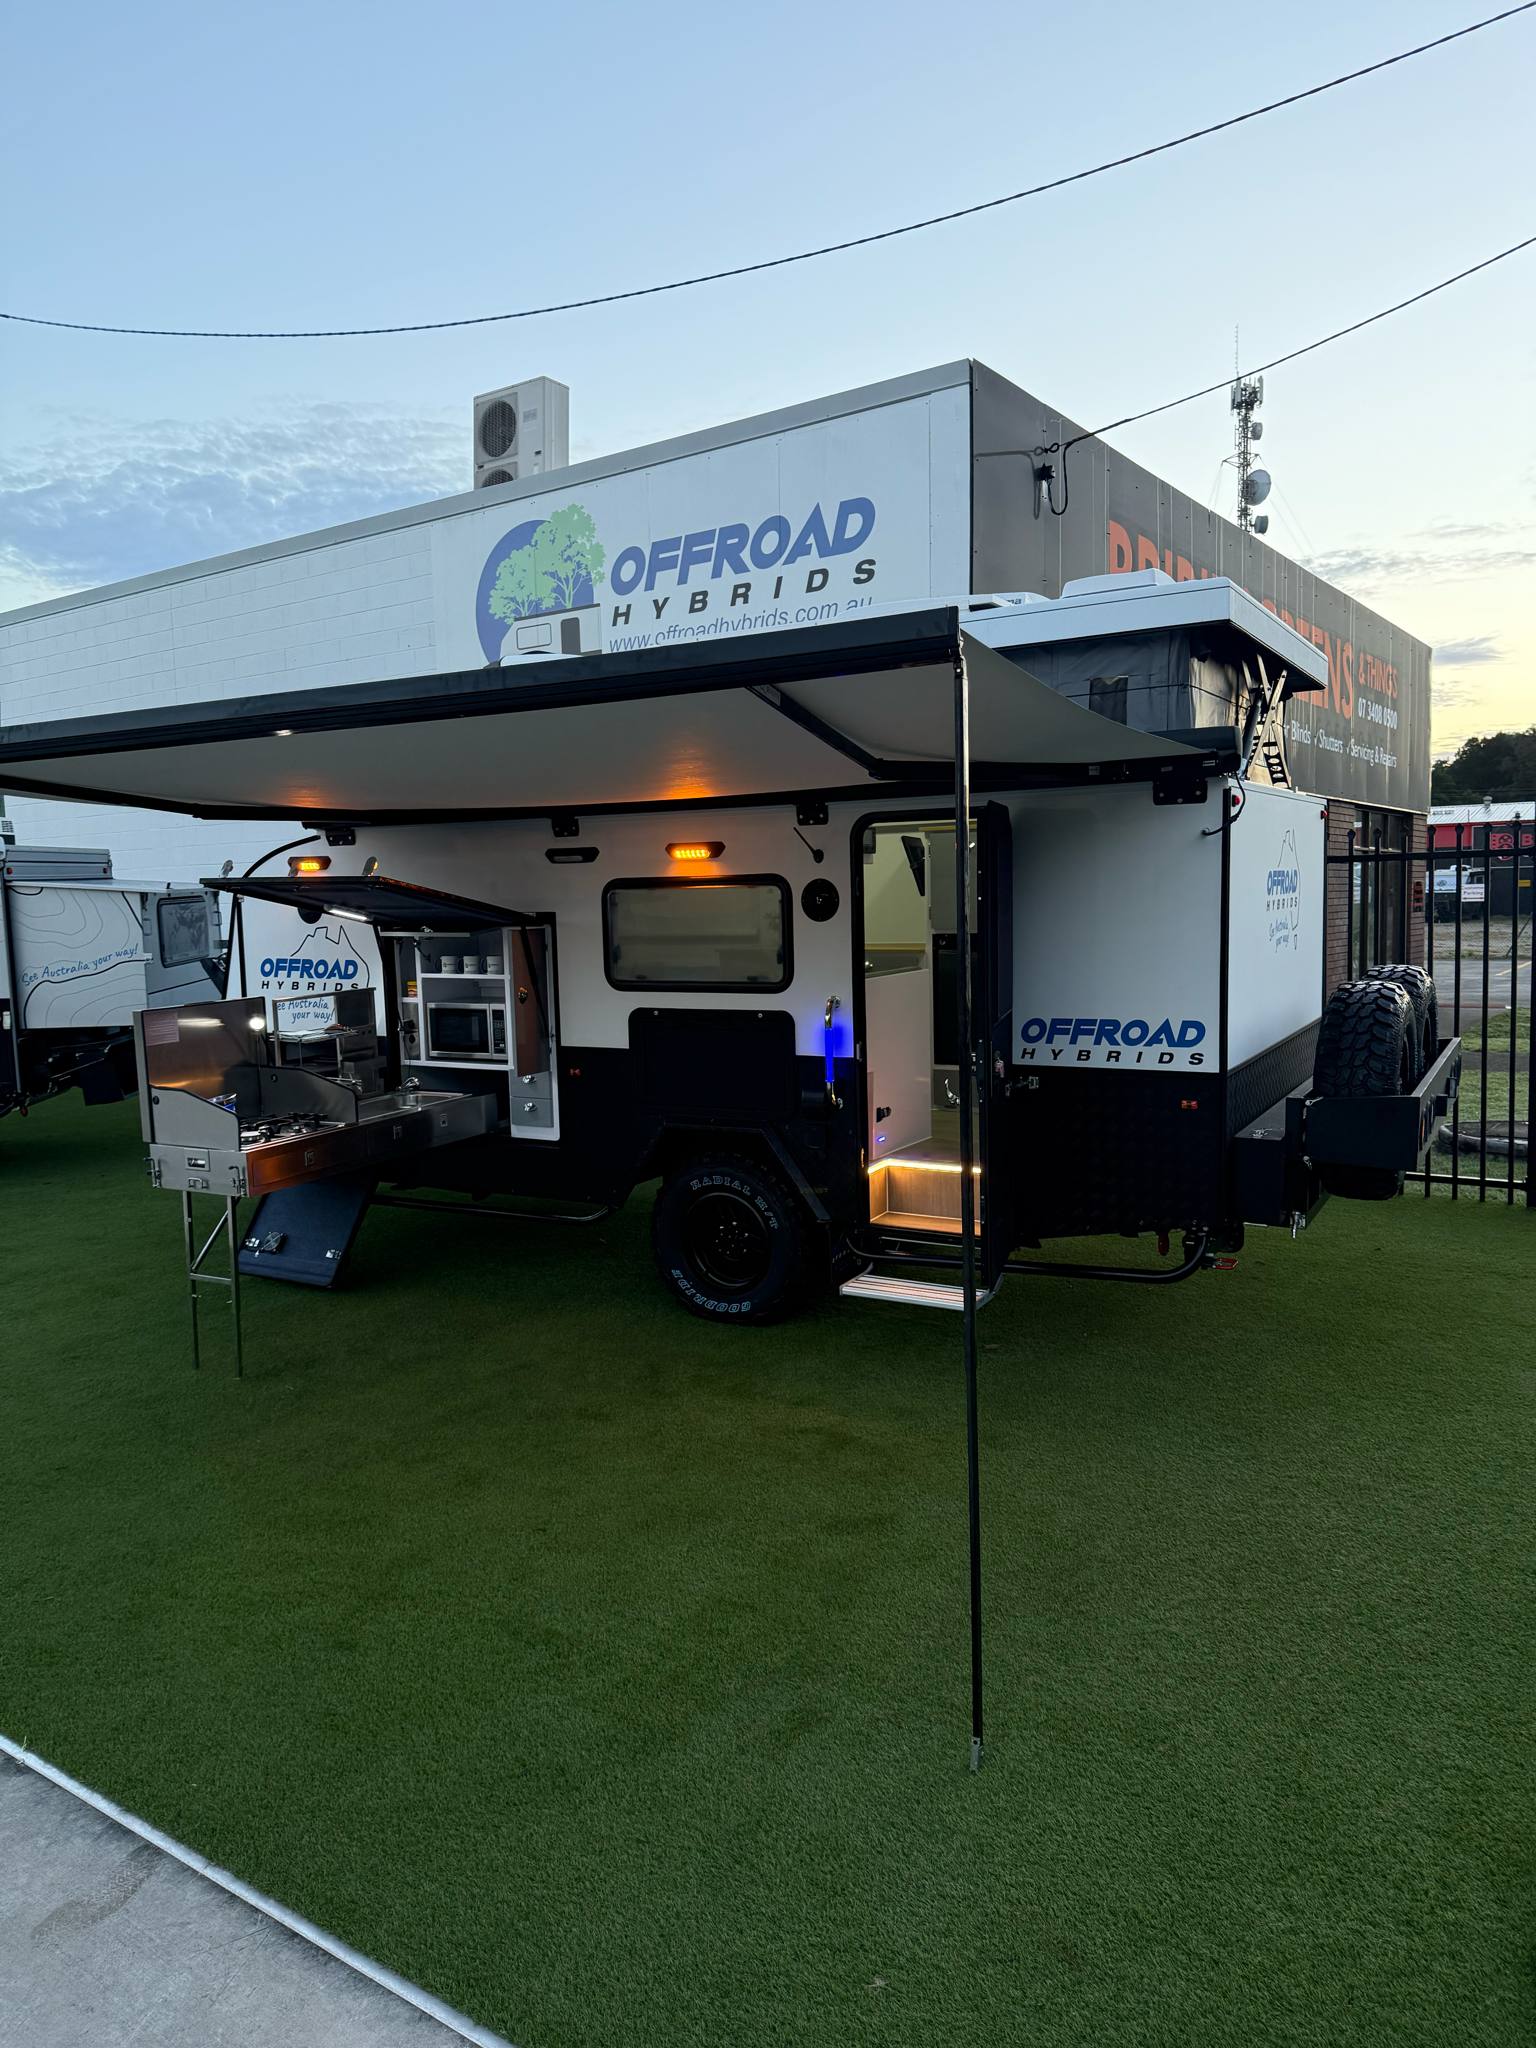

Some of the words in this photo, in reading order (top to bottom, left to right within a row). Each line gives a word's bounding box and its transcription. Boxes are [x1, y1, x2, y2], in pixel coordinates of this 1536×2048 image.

[611, 497, 876, 596] OFFROAD
[612, 559, 876, 626] HYBRIDS
[609, 597, 873, 652] www.offroadhybrids.comau
[1366, 654, 1398, 699] THINGS
[1358, 697, 1367, 717] 07
[1291, 720, 1312, 744] Blinds
[1319, 728, 1343, 753] Shutters
[1351, 739, 1374, 767] Servicing
[1267, 869, 1298, 896] OFFROAD
[1266, 897, 1298, 912] HYBRIDS
[22, 972, 38, 986] See
[42, 962, 90, 979] Australia
[93, 953, 112, 971] your
[115, 943, 138, 959] way!
[260, 958, 358, 979] OFFROAD
[261, 980, 360, 991] HYBRIDS
[288, 998, 329, 1010] Australia
[292, 1011, 311, 1024] your
[313, 1007, 336, 1024] way!
[1021, 1017, 1206, 1048] OFFROAD
[1020, 1048, 1205, 1065] HYBRIDS
[690, 1175, 751, 1196] RADIAL
